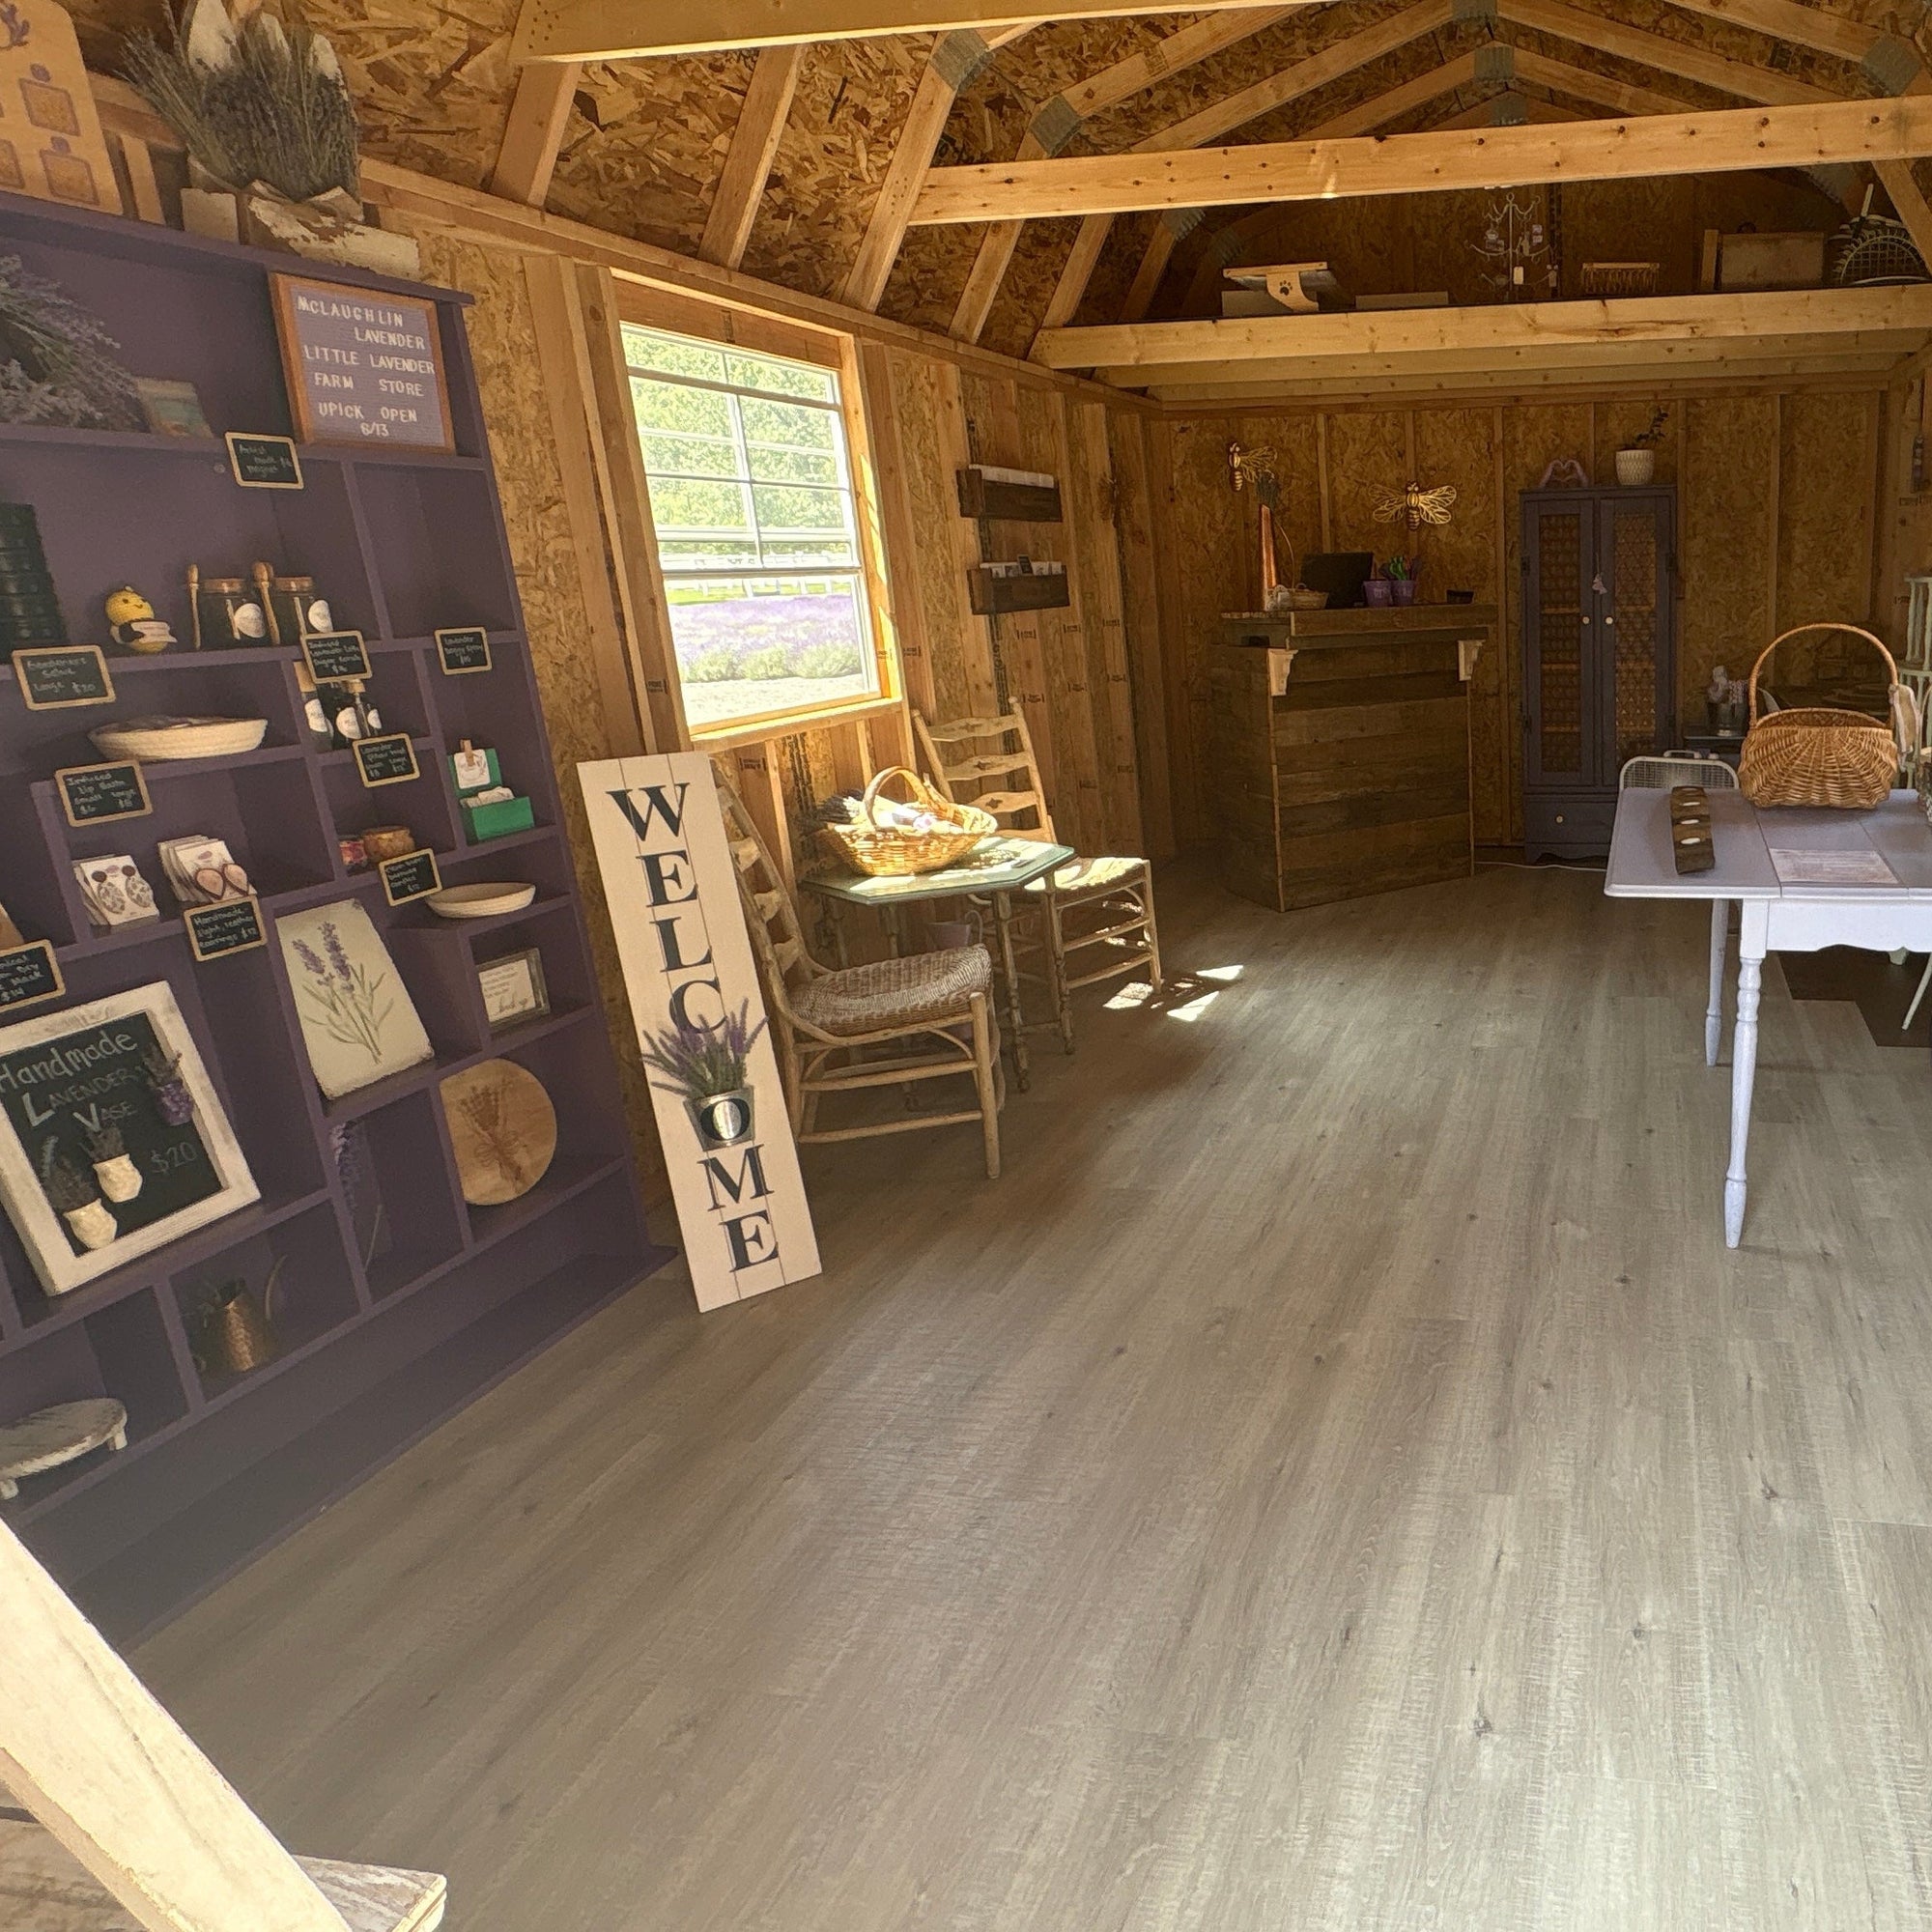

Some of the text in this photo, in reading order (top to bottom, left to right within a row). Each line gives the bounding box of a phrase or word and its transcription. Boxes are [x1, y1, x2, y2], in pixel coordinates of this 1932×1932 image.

[298, 296, 403, 327] MCLAUGHLIN
[355, 327, 426, 350] LAVENDER
[303, 345, 435, 375] LITTLE LAVENDER
[314, 372, 424, 397] FARM STORE
[319, 401, 417, 422] UPICK OPEN
[606, 781, 780, 1273] WELCOME
[0, 1031, 138, 1093] Handmade
[150, 1140, 198, 1174] $20
